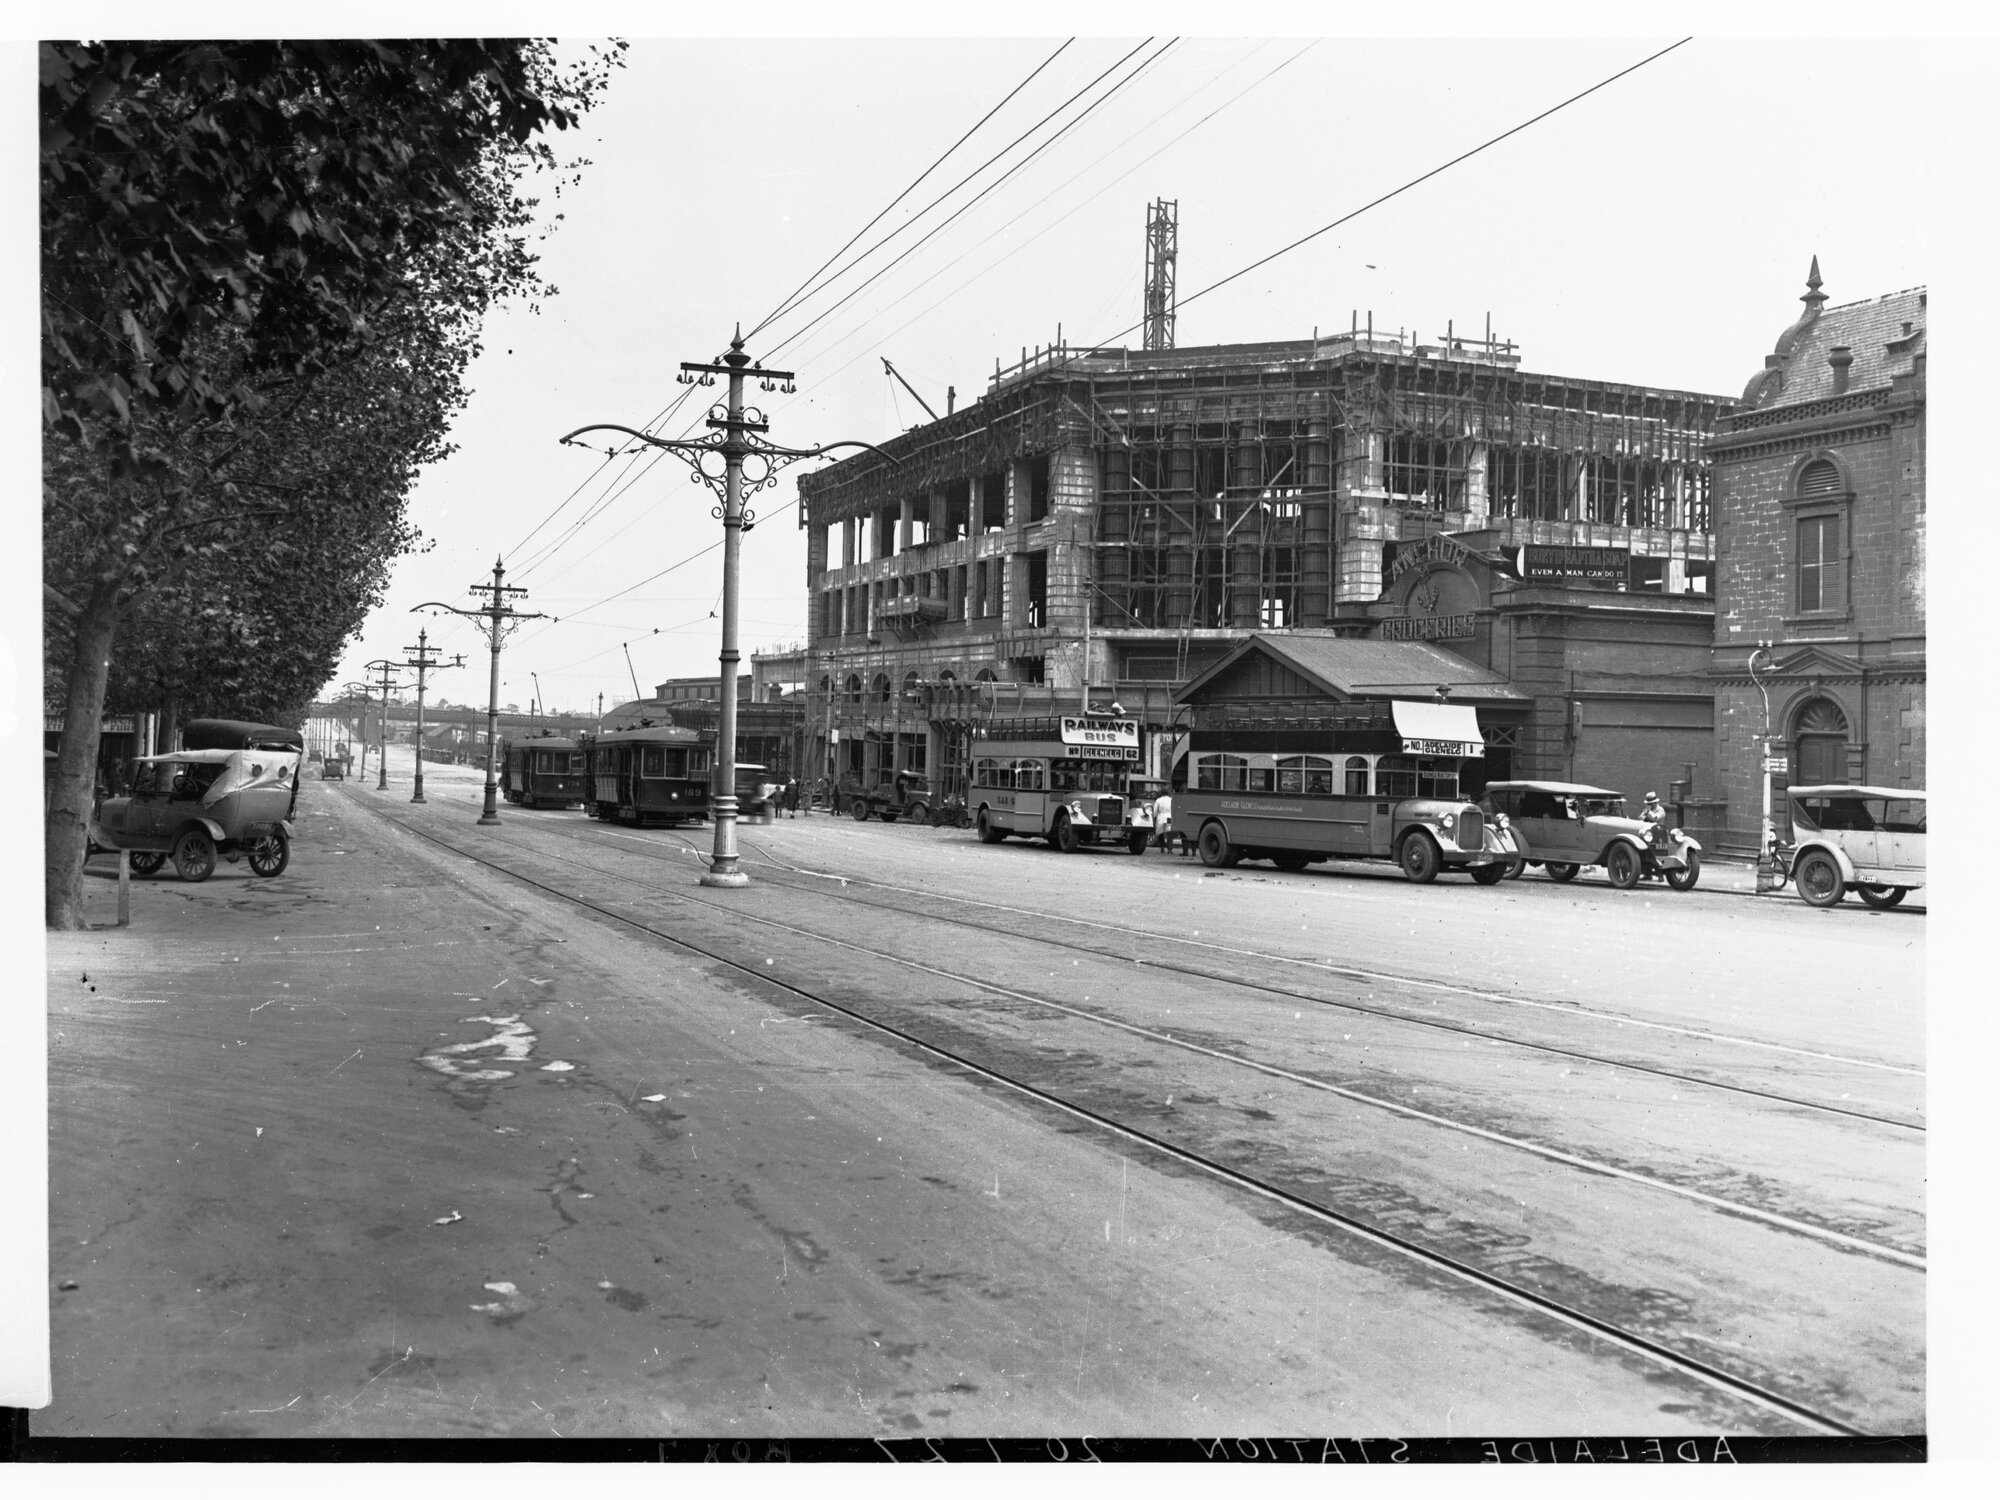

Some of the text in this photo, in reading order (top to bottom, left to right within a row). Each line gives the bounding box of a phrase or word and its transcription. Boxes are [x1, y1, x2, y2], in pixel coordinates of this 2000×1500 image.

[1391, 537, 1468, 582] ANCHOR
[1604, 551, 1628, 567] SOAP
[1531, 568, 1553, 576] EVEN
[1566, 569, 1583, 577] MAN
[1381, 613, 1475, 640] GROCERIES
[1064, 719, 1135, 736] RAILWAYS
[1084, 732, 1117, 742] BUS
[1424, 741, 1462, 749] ADELAIDE
[1126, 749, 1138, 759] 62
[1424, 747, 1462, 755] GLENELG
[684, 788, 702, 797] 189
